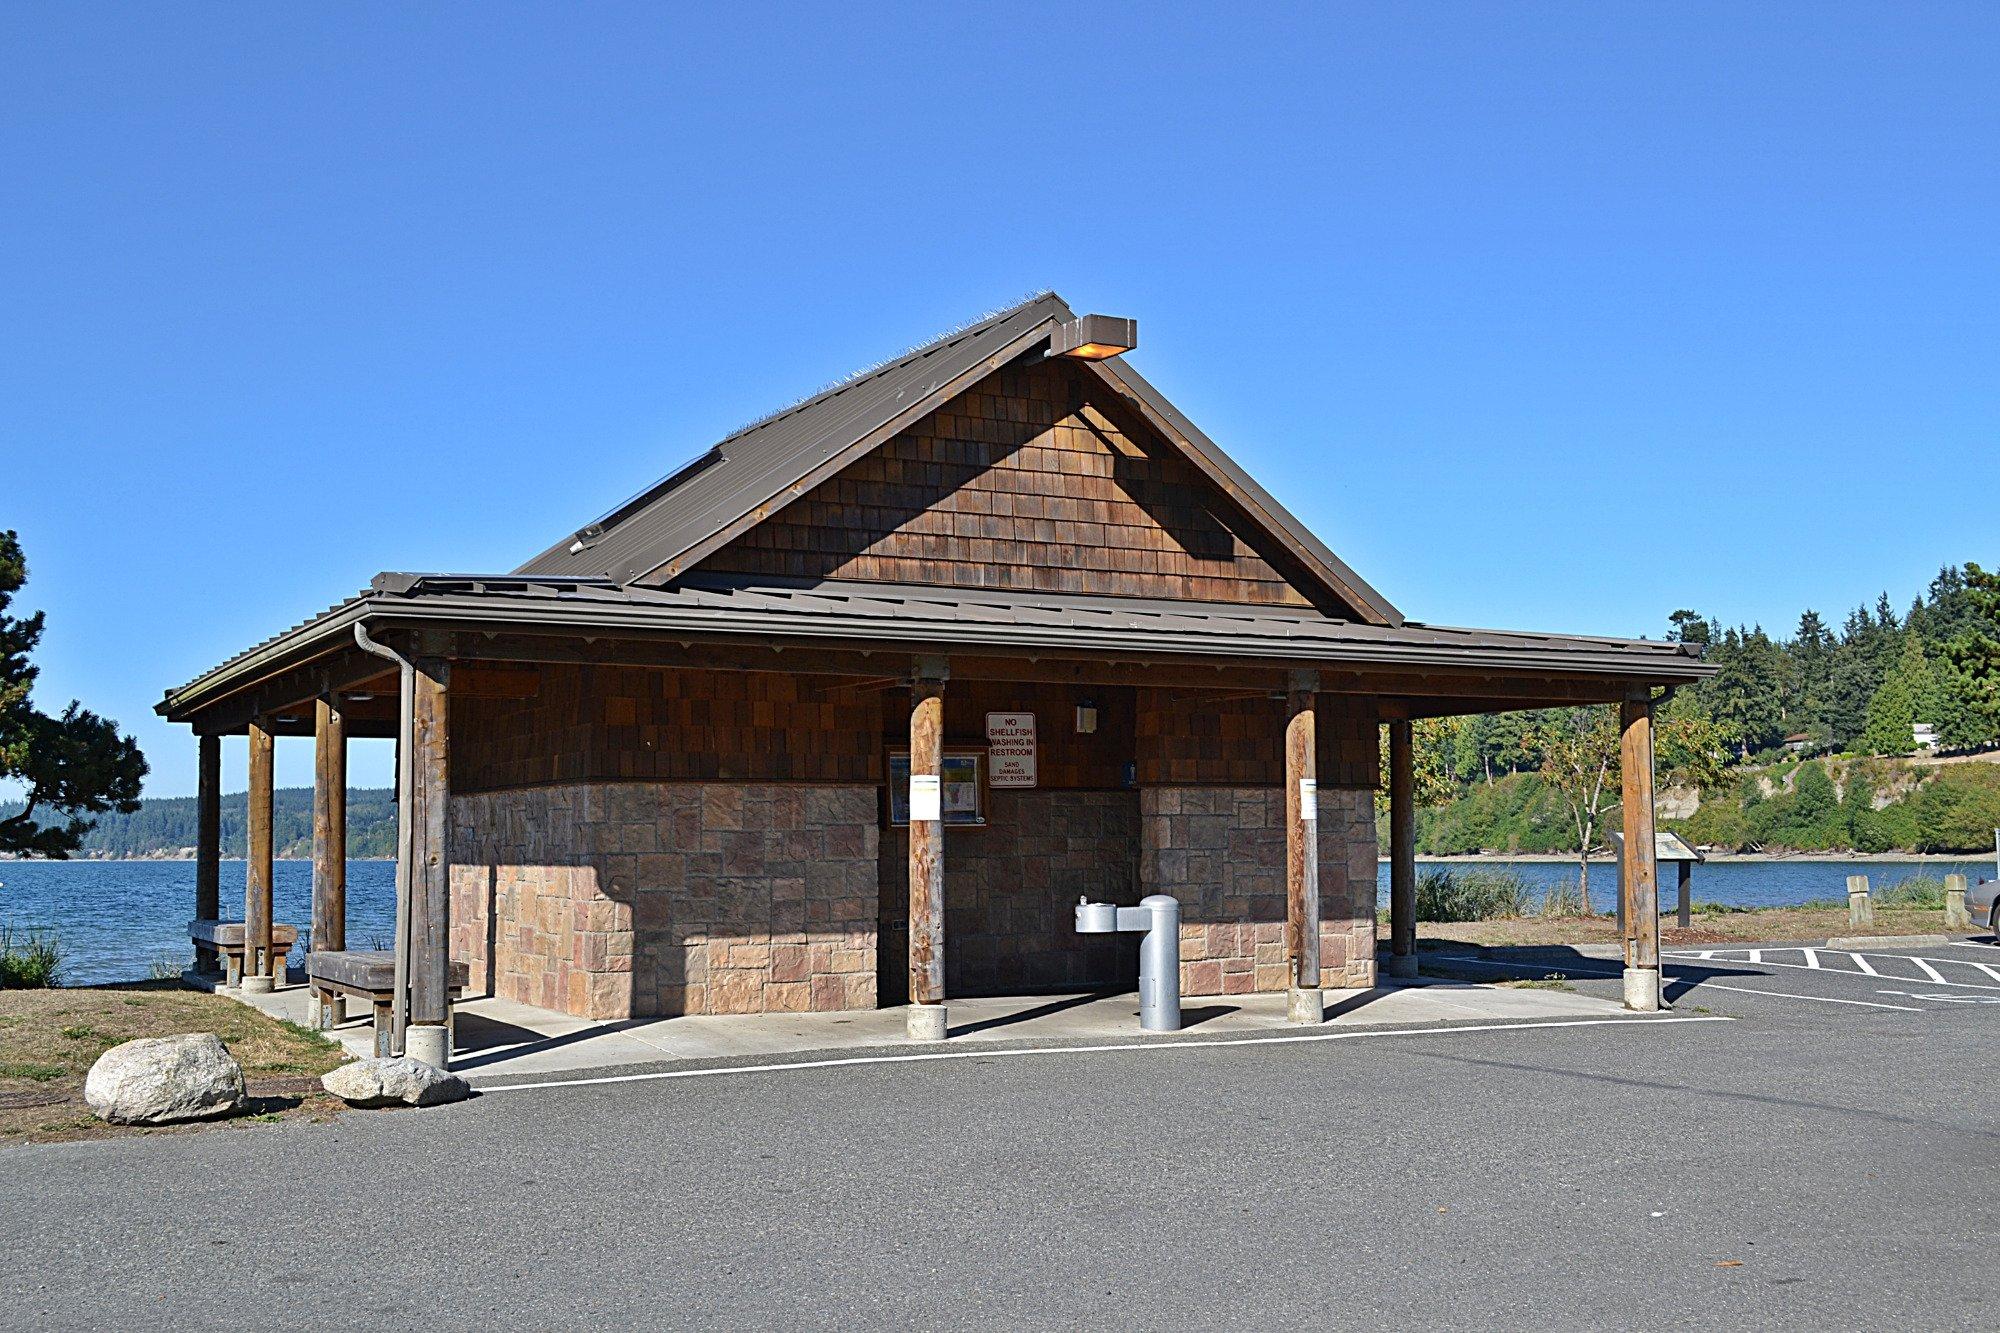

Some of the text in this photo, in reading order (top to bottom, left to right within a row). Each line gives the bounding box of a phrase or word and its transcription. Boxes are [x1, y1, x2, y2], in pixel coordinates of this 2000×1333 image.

[1005, 718, 1017, 726] NO
[990, 728, 1033, 736] SHELLFISH
[990, 748, 1033, 756] RESTROOM
